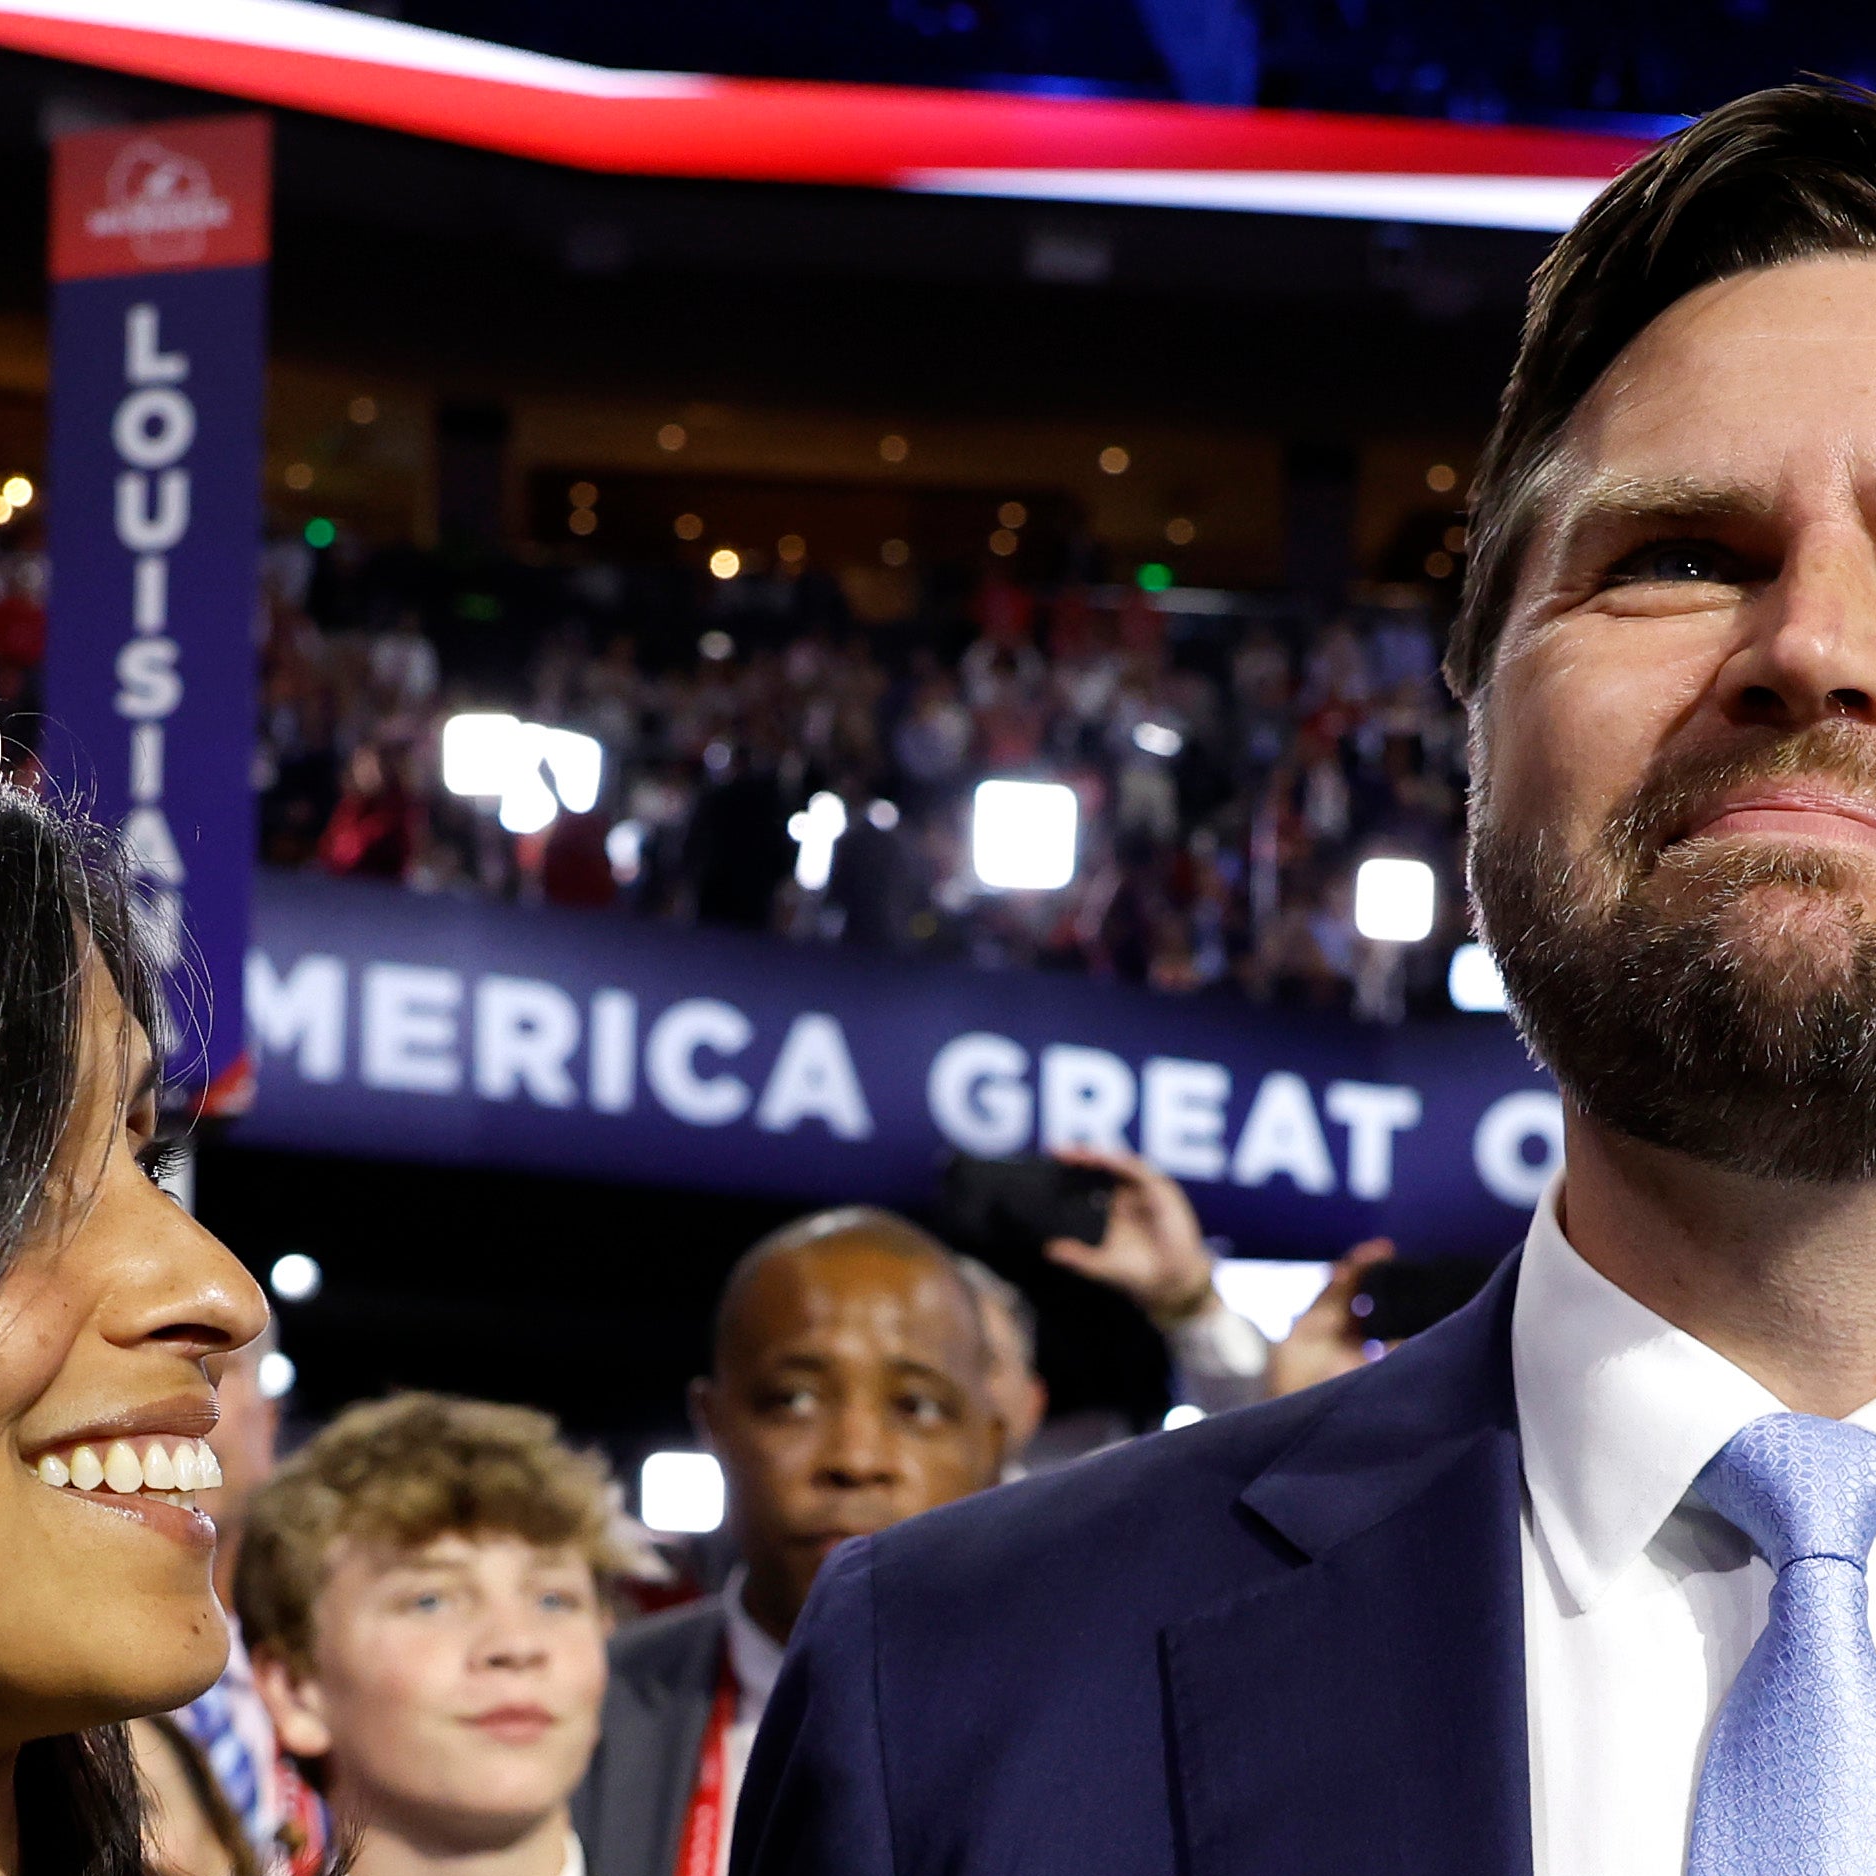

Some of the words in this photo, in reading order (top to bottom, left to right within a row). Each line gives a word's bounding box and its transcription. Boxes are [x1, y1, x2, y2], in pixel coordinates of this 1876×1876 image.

[111, 303, 198, 1055] LOUISIAN
[243, 947, 875, 1143] MERICA
[927, 1030, 1422, 1200] GREAT
